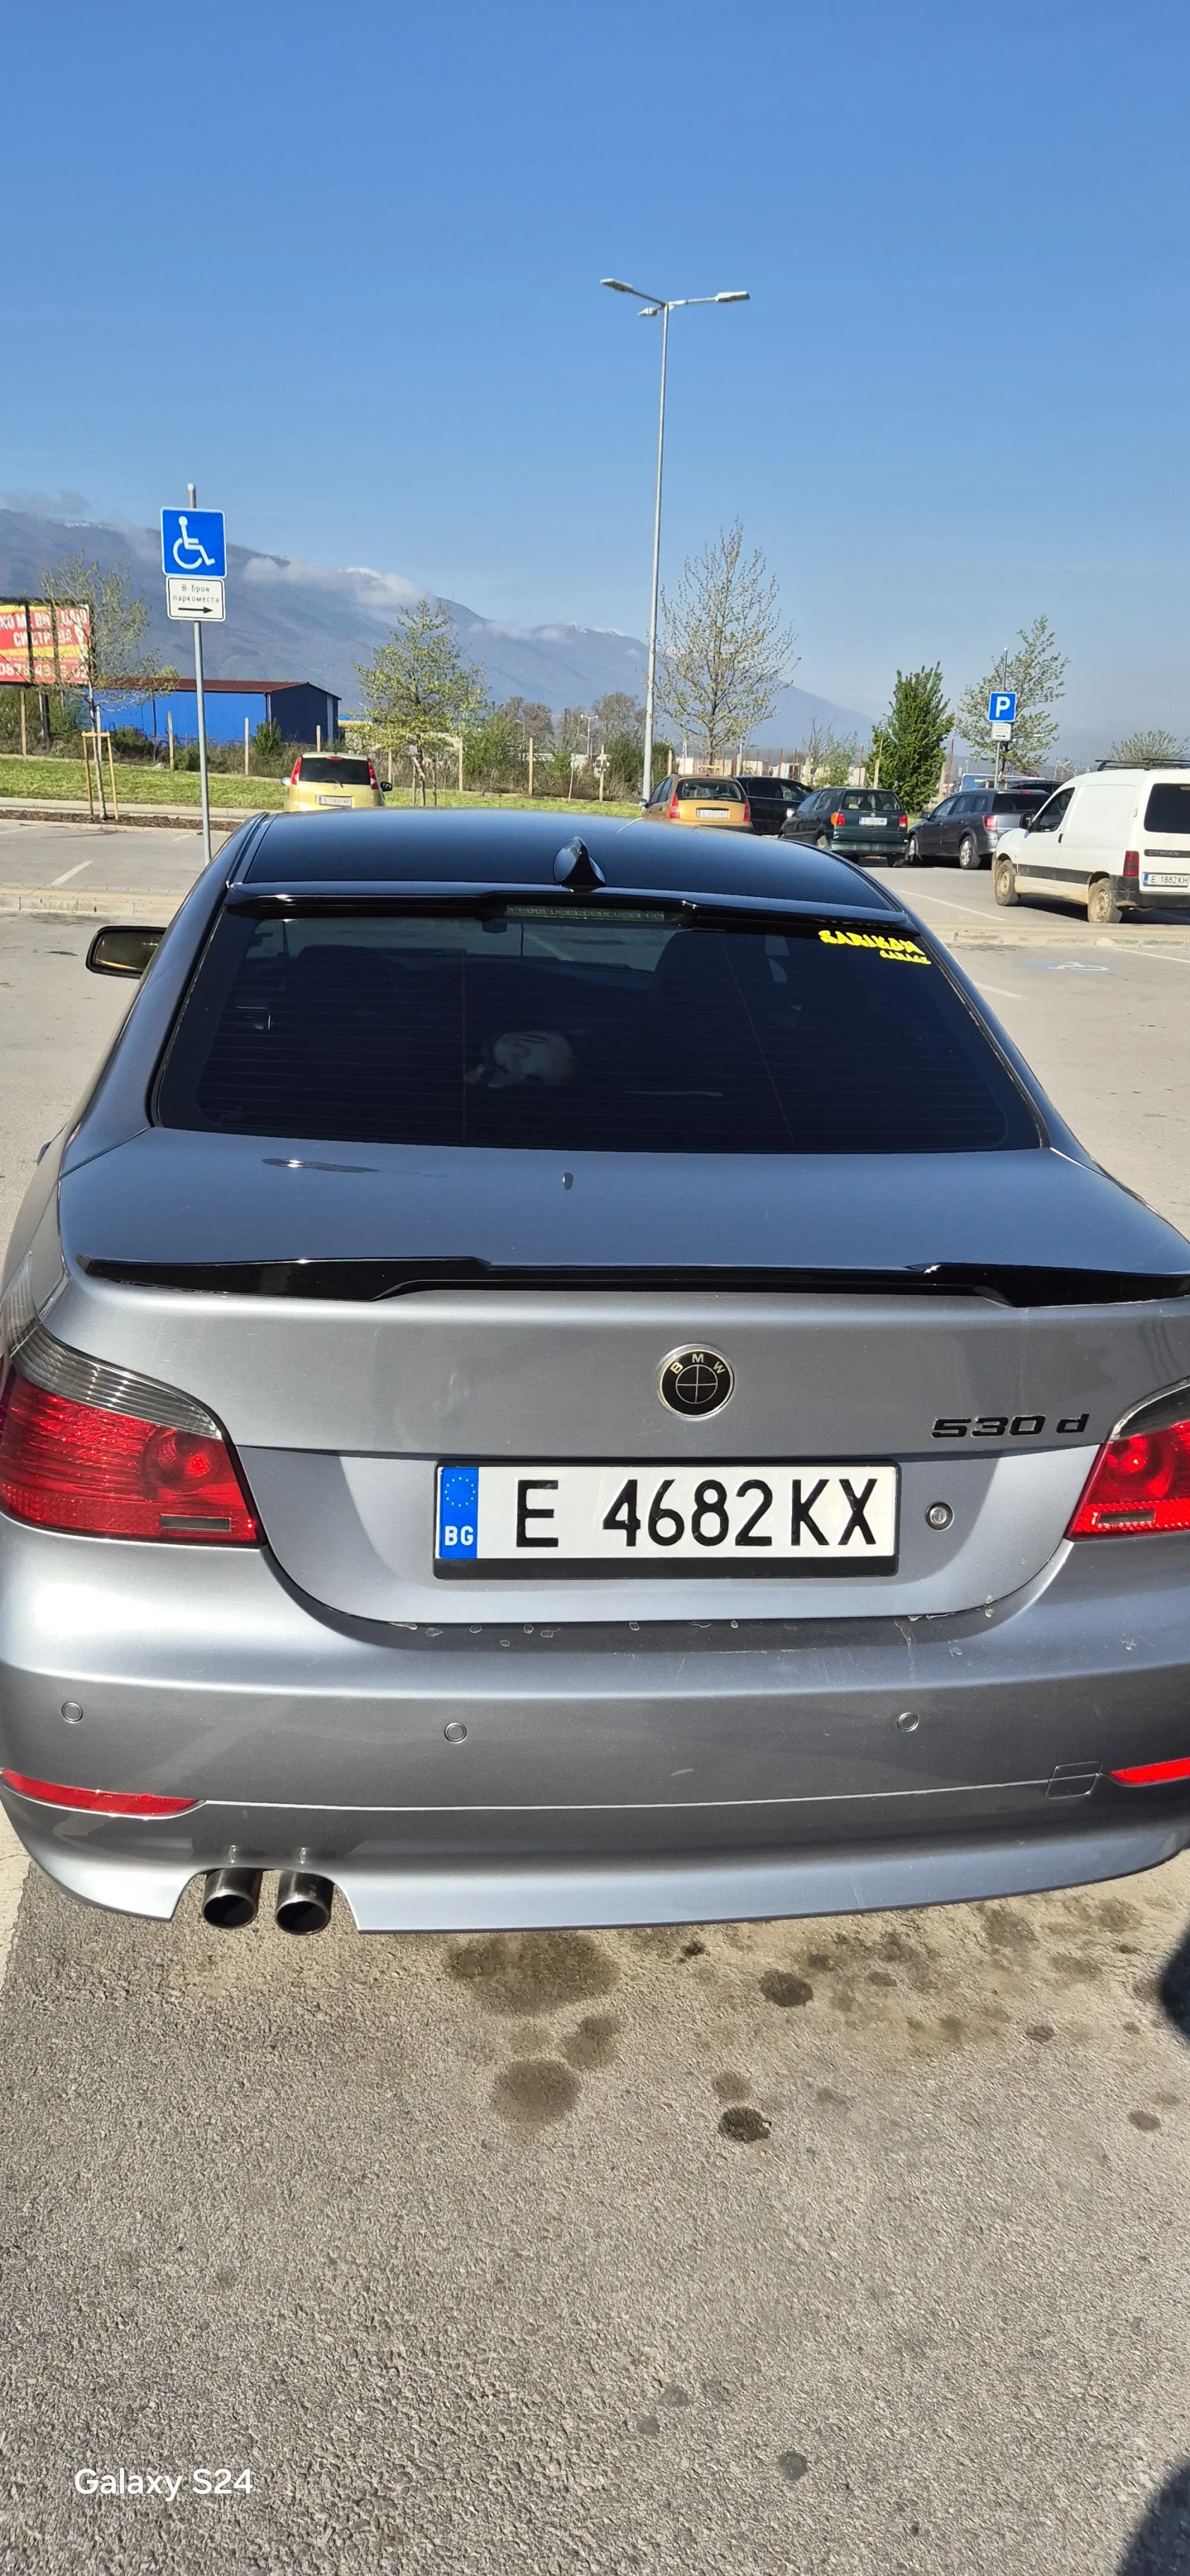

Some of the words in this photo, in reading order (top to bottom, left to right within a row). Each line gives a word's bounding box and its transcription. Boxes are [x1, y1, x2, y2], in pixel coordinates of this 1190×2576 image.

[173, 595, 219, 603] паркоместа
[191, 584, 210, 593] броя
[996, 696, 1011, 718] P
[879, 949, 932, 965] GARAGE
[670, 1353, 726, 1375] BMW
[930, 1415, 1046, 1438] 530
[1055, 1413, 1090, 1433] d
[516, 1480, 559, 1548] E
[444, 1526, 475, 1546] BG
